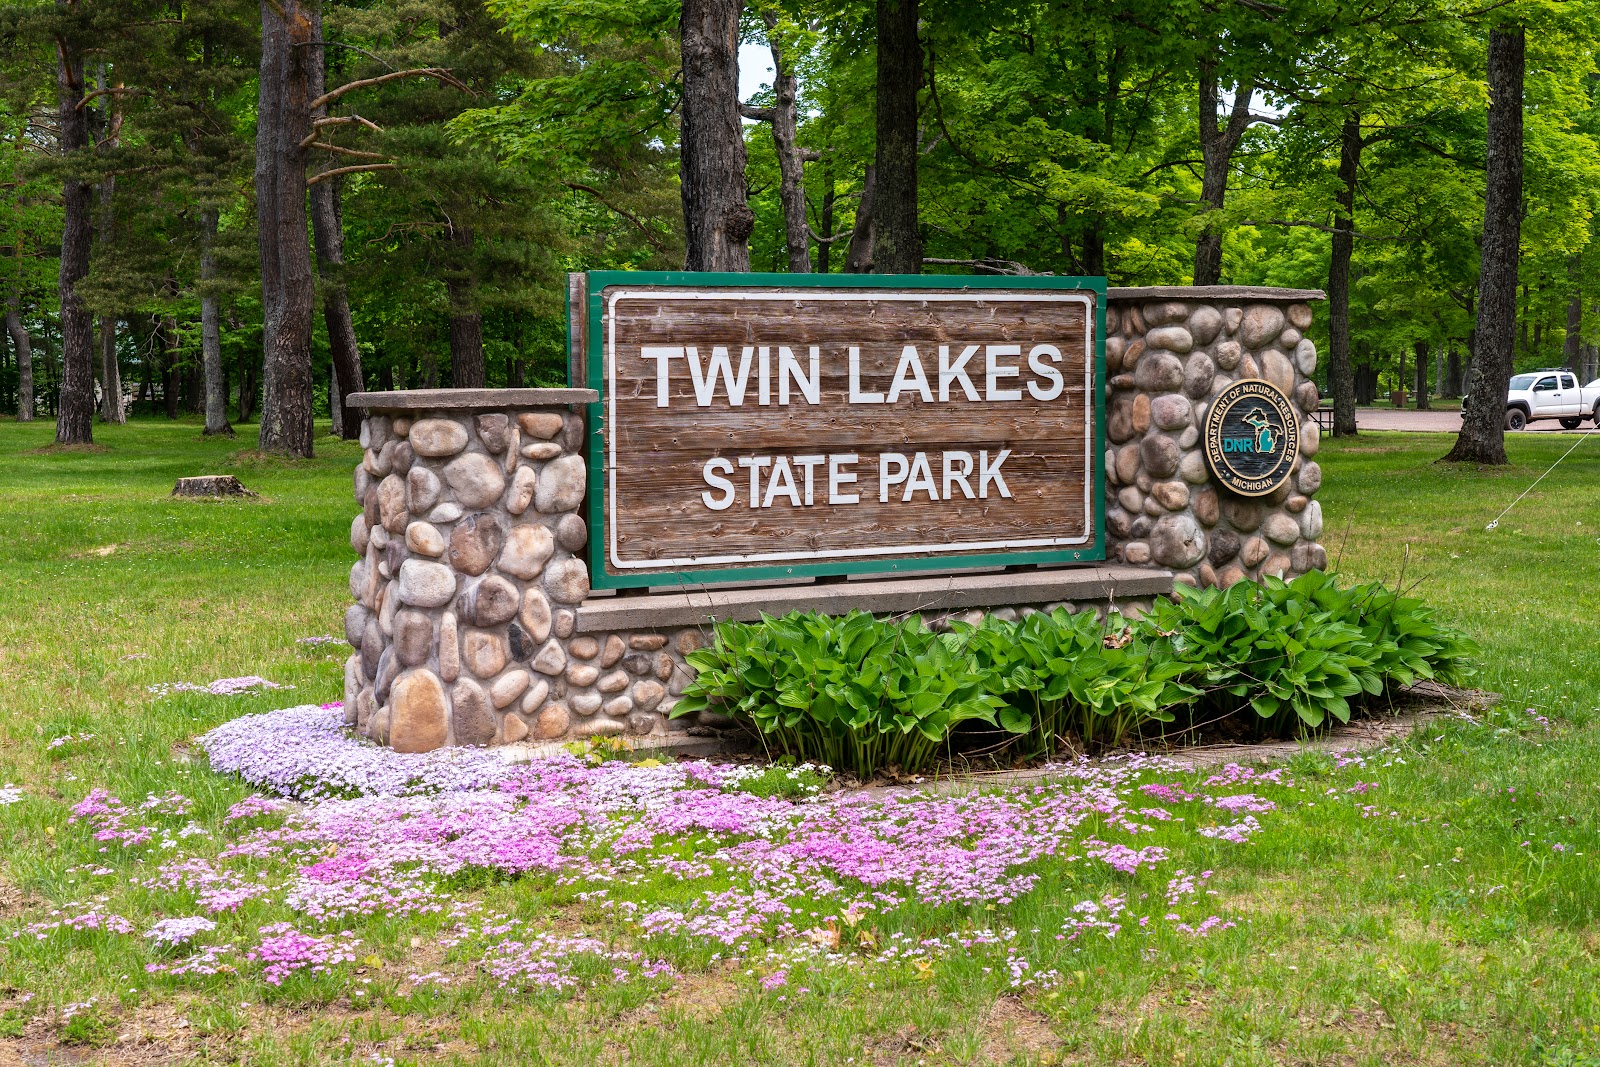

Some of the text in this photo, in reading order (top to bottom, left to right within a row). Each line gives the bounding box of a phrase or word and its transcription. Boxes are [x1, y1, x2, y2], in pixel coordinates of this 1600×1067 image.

[641, 344, 1064, 407] TWIN LAKES
[1209, 384, 1296, 463] DEPARTMENT OF NATURAL RESOURCES
[1223, 438, 1254, 453] DNR
[701, 449, 1012, 511] STATE PARK
[1231, 476, 1273, 491] MICHIGAN
